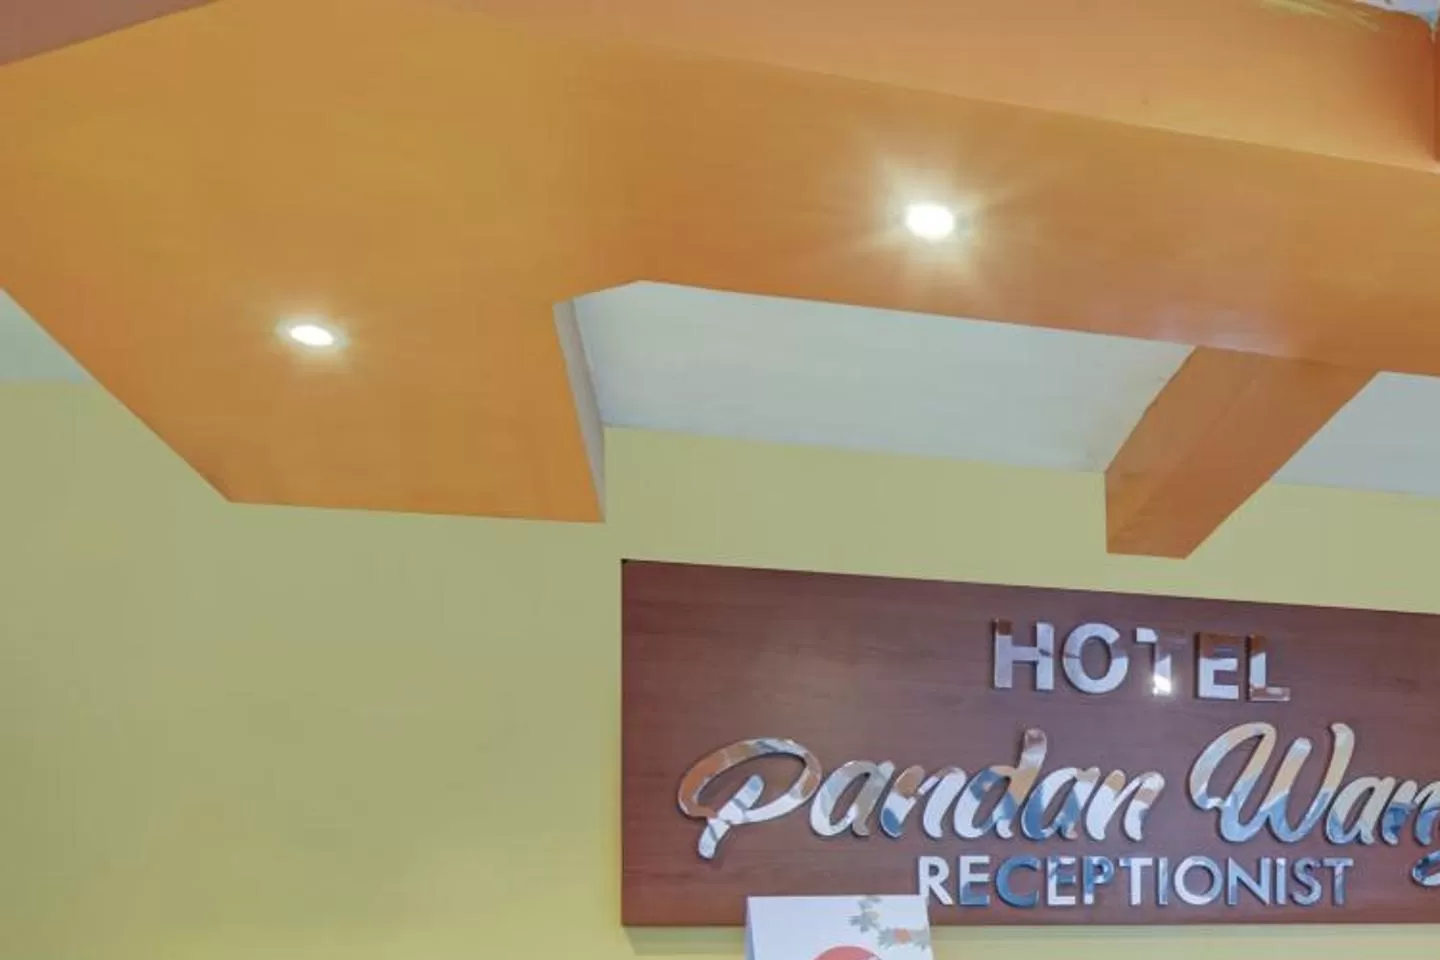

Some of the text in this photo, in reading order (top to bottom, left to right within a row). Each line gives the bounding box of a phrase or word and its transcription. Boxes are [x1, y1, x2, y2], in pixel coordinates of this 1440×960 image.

[992, 619, 1291, 702] HOTEL
[677, 727, 1165, 860] Pandan
[919, 854, 1354, 907] RECEPTIONIST
